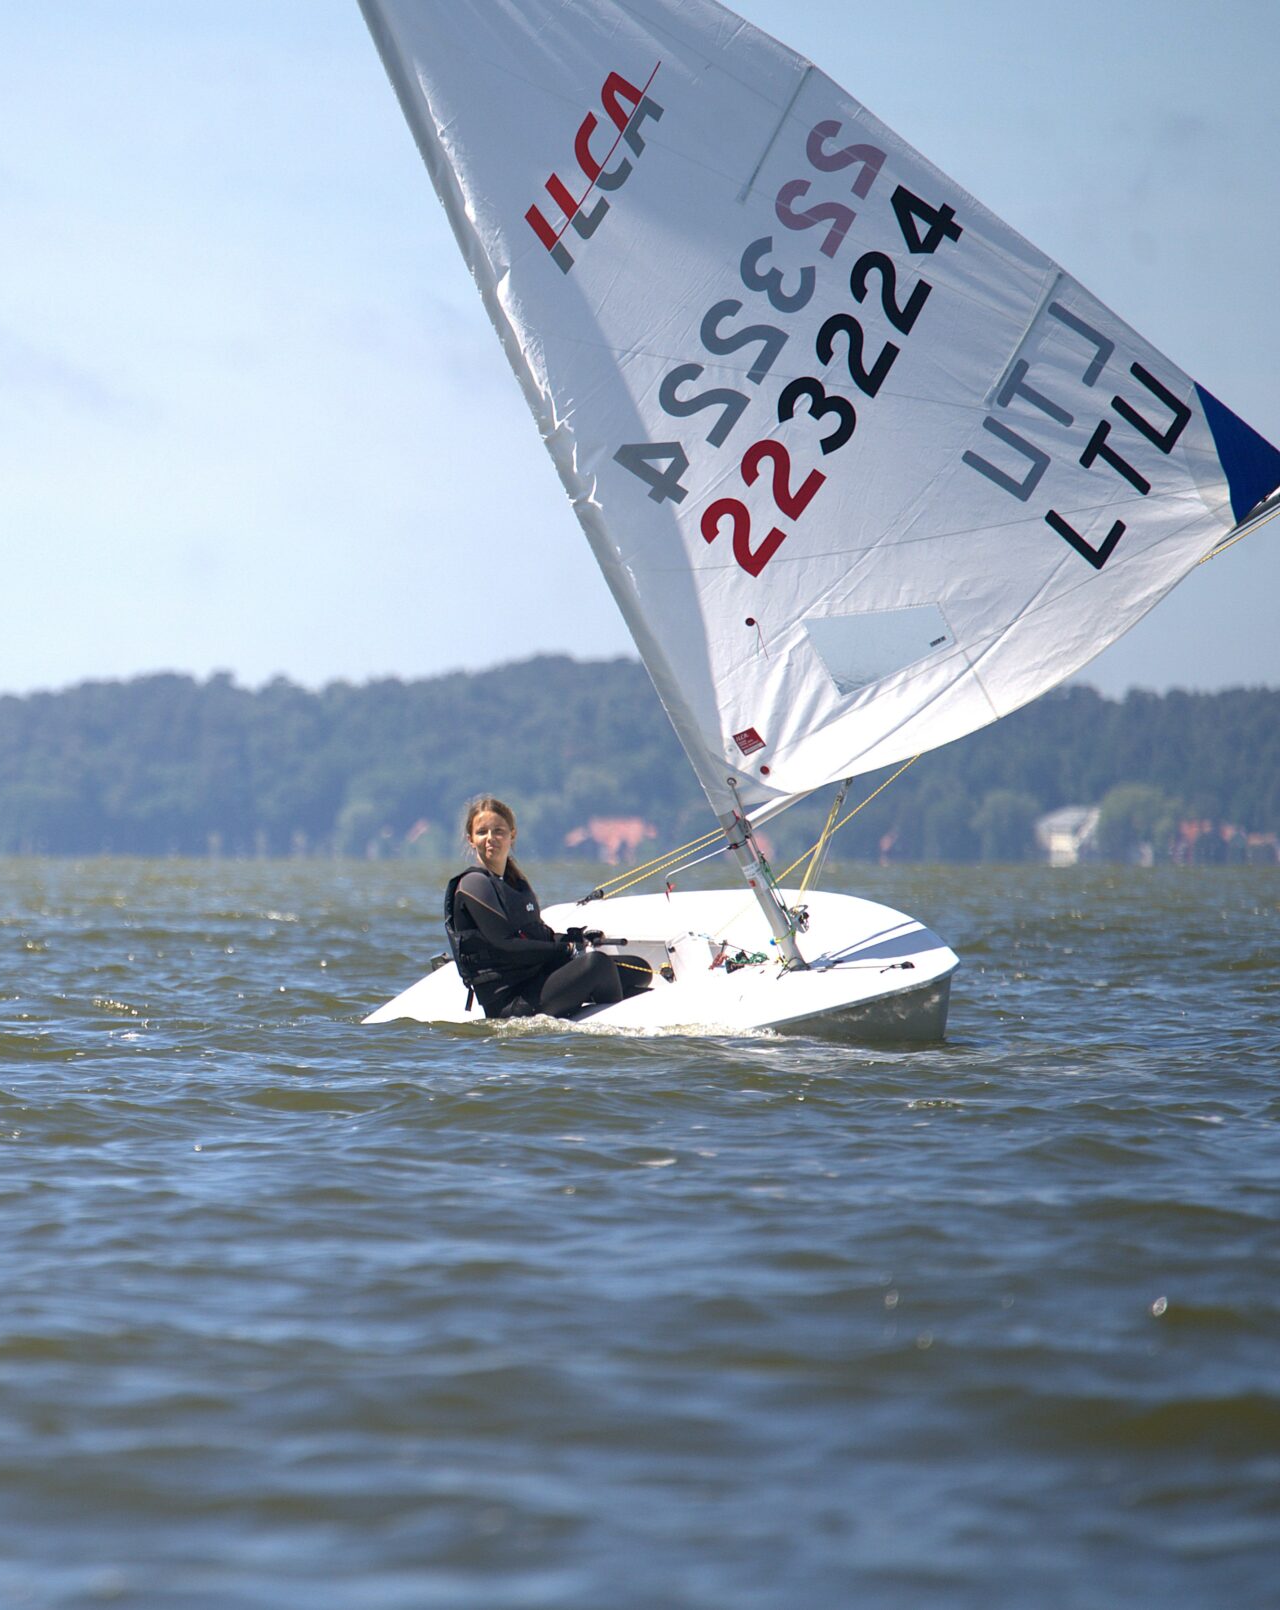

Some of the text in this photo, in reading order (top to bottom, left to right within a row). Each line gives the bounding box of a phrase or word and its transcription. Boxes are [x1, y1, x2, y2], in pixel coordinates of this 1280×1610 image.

[524, 62, 664, 274] ILCA
[700, 185, 963, 577] 223224
[1044, 362, 1192, 569] LTU
